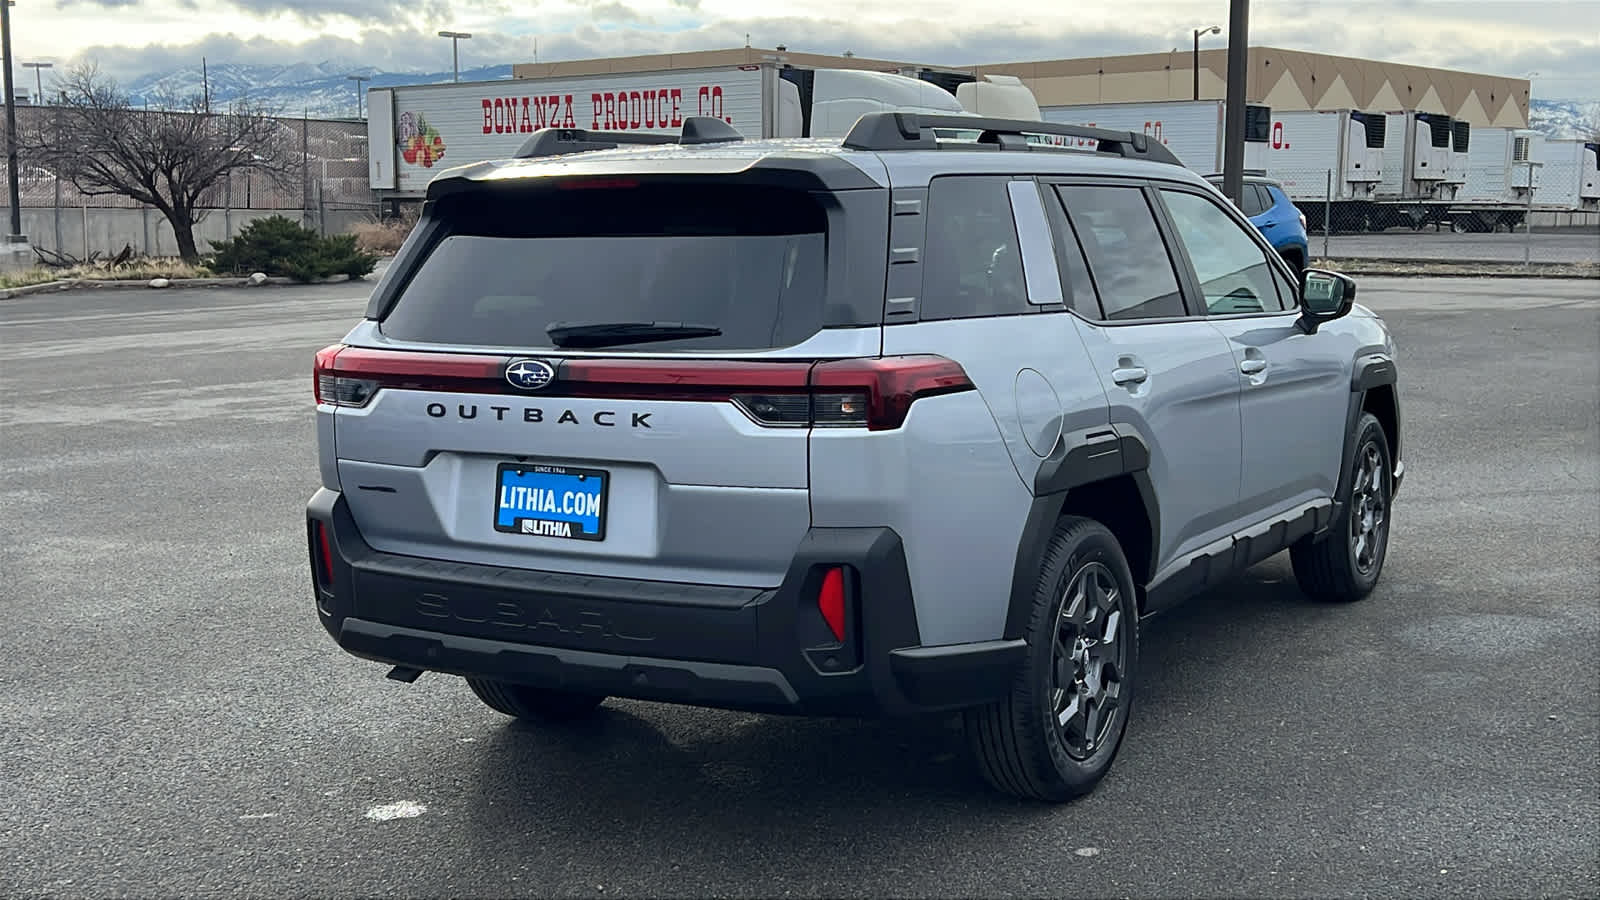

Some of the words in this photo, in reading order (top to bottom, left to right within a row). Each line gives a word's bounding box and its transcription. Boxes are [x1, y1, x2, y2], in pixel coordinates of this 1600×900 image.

[482, 94, 576, 135] BONANZA
[591, 88, 682, 130] PRODUCE
[698, 86, 731, 124] CO.
[426, 402, 653, 429] OUTBACK
[500, 485, 601, 517] LITHIA.COM
[533, 520, 571, 537] LITHIA
